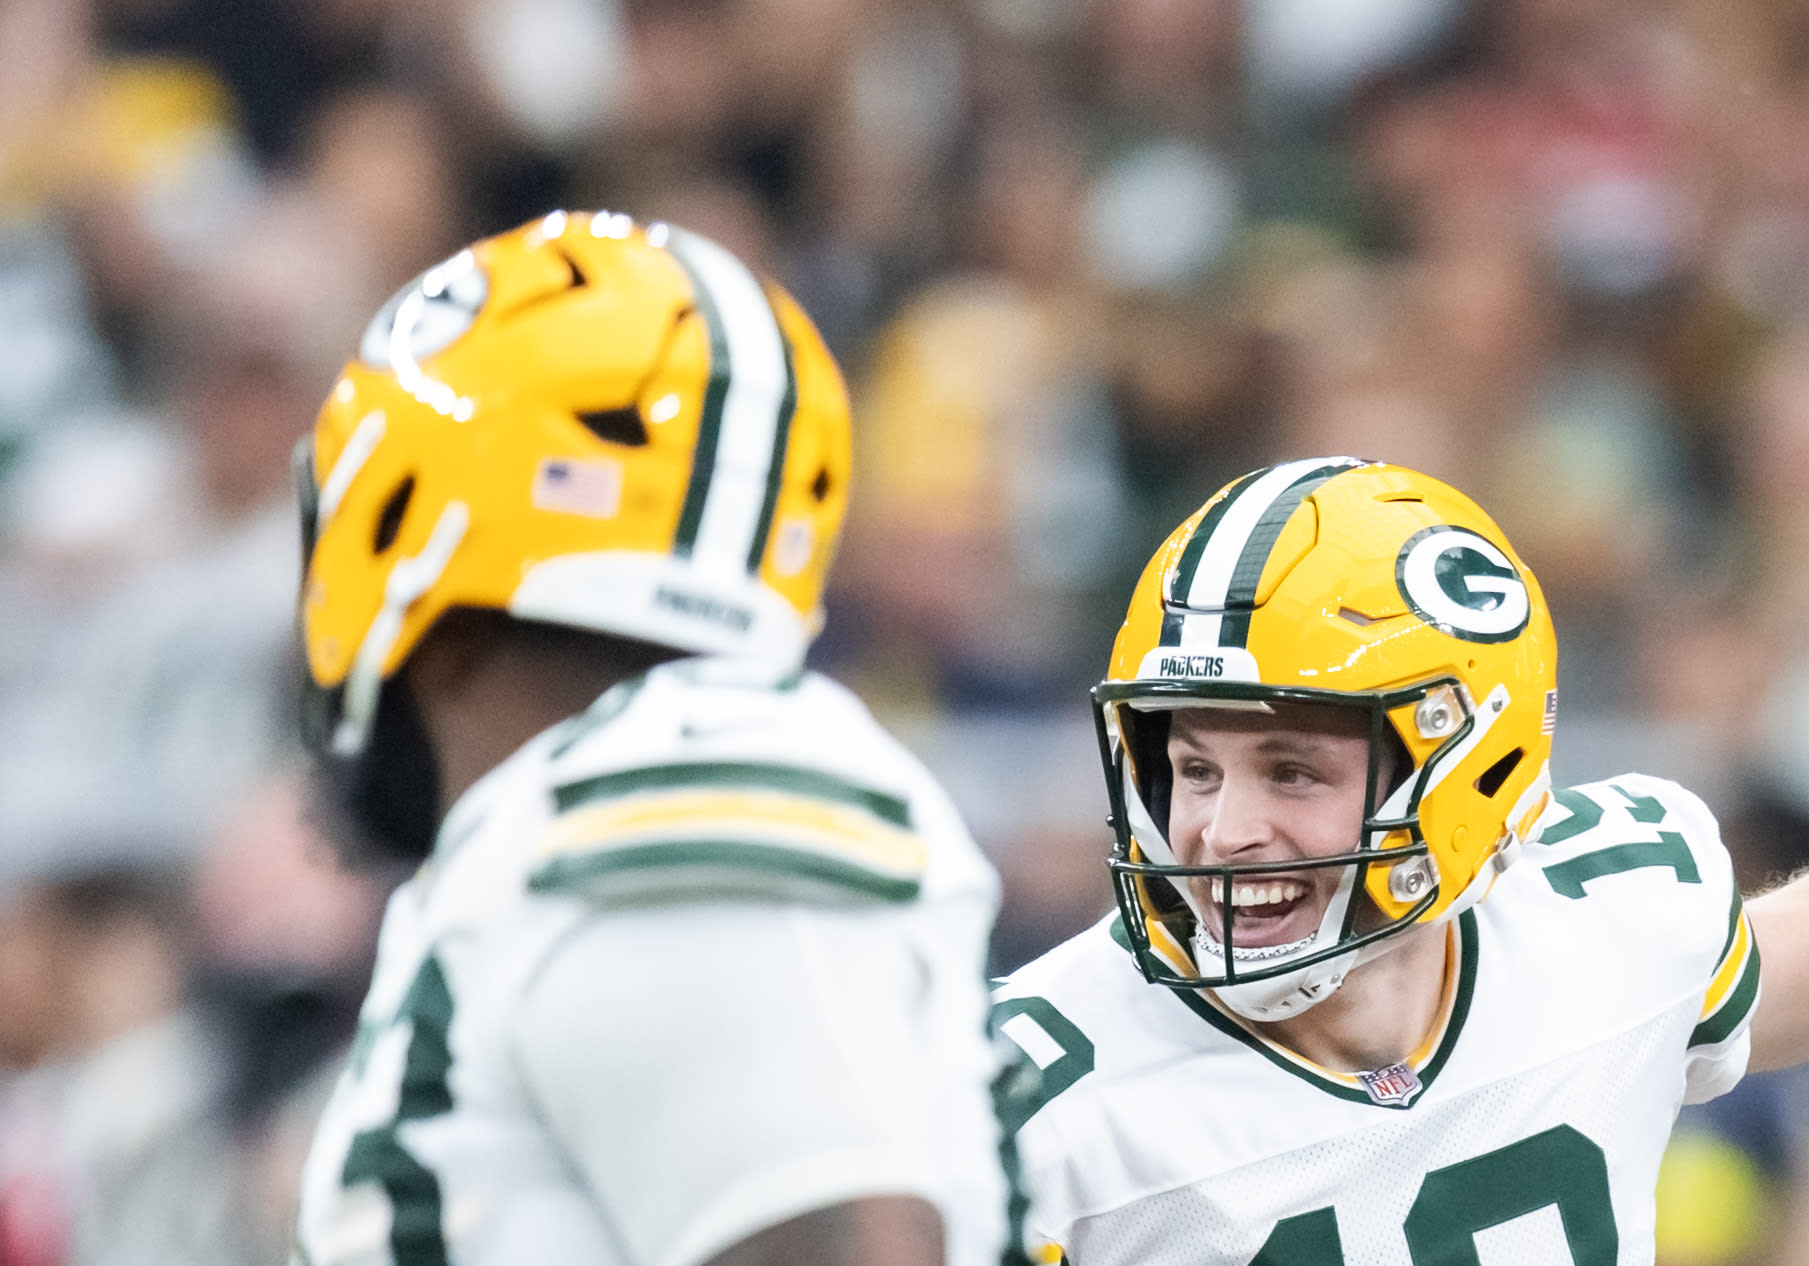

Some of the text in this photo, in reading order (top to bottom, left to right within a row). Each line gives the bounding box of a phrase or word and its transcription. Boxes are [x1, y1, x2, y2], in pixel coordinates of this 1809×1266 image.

[1403, 530, 1528, 635] G
[1160, 656, 1224, 677] PACKERS
[1373, 1074, 1413, 1097] NFL
